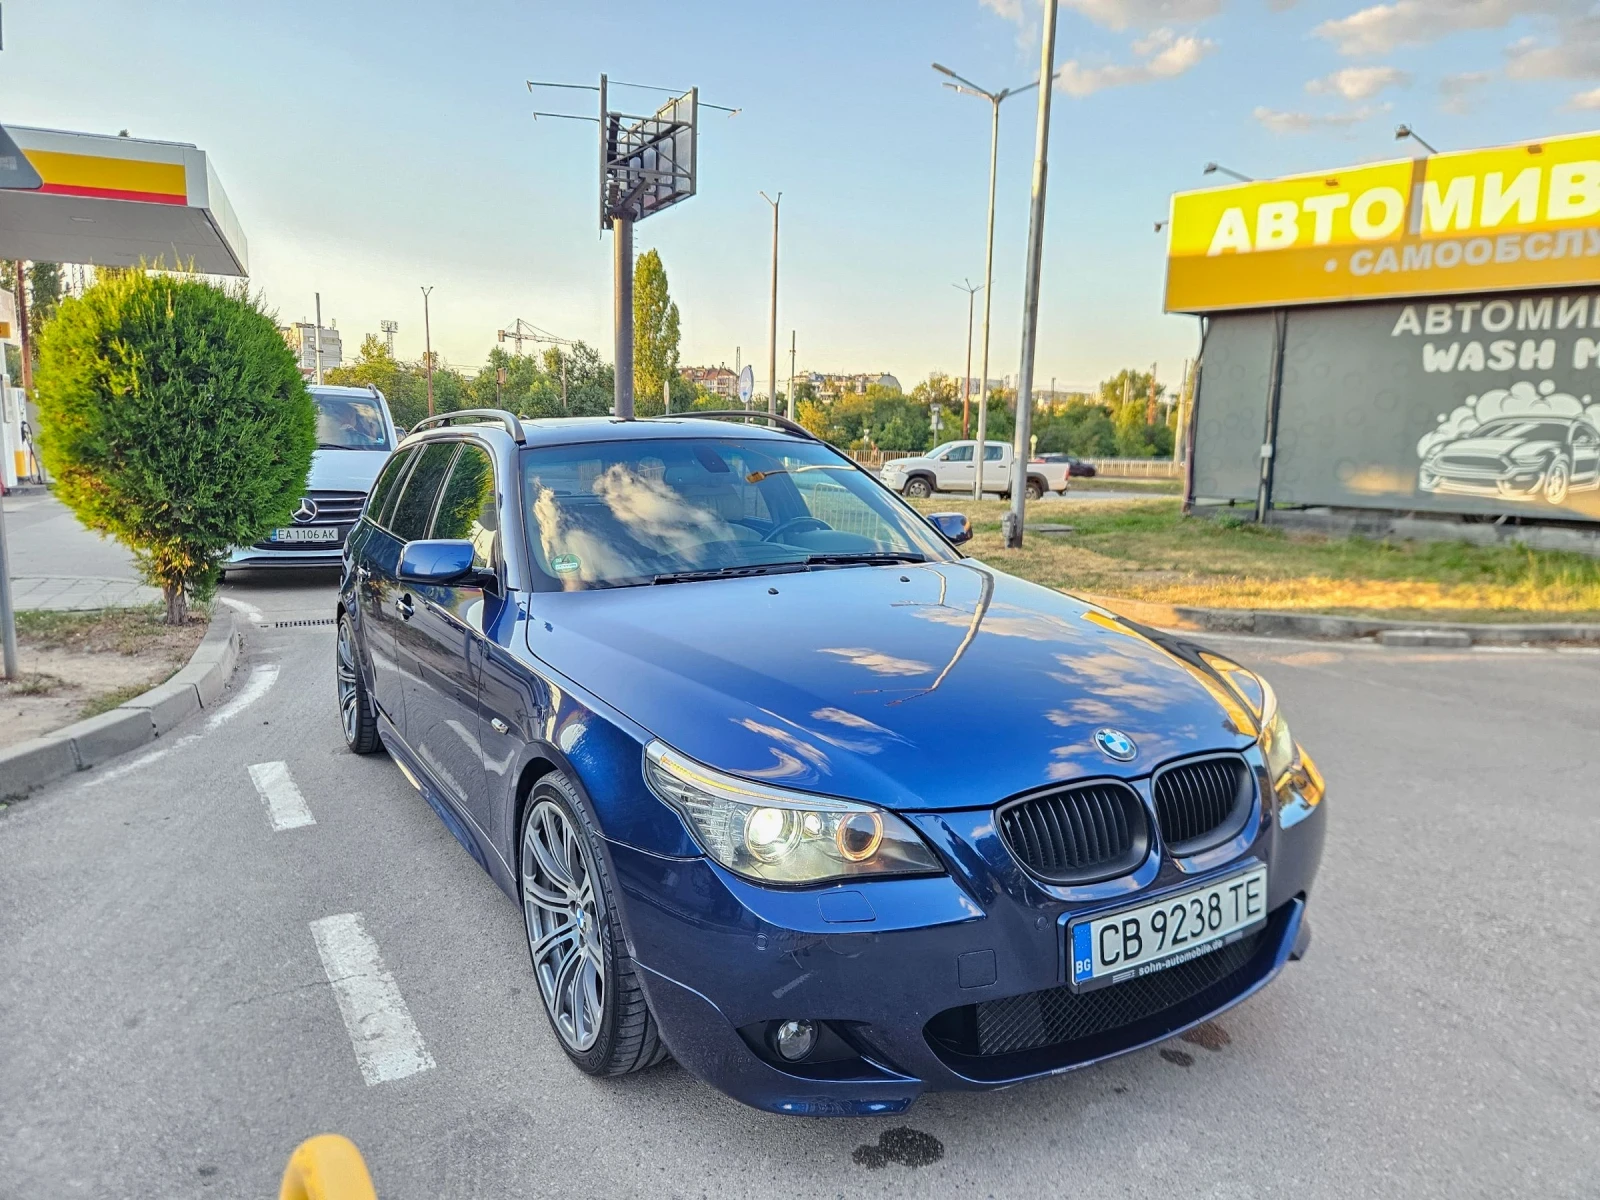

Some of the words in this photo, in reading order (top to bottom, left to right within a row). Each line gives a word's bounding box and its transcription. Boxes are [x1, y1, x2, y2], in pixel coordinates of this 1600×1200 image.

[1422, 338, 1556, 373] WASH
[278, 529, 292, 540] EA
[296, 529, 320, 540] 1106
[322, 529, 335, 540] AK
[1099, 918, 1143, 966] CB
[1151, 892, 1222, 951] 9238
[1229, 877, 1261, 922] TE
[1075, 960, 1091, 974] BG
